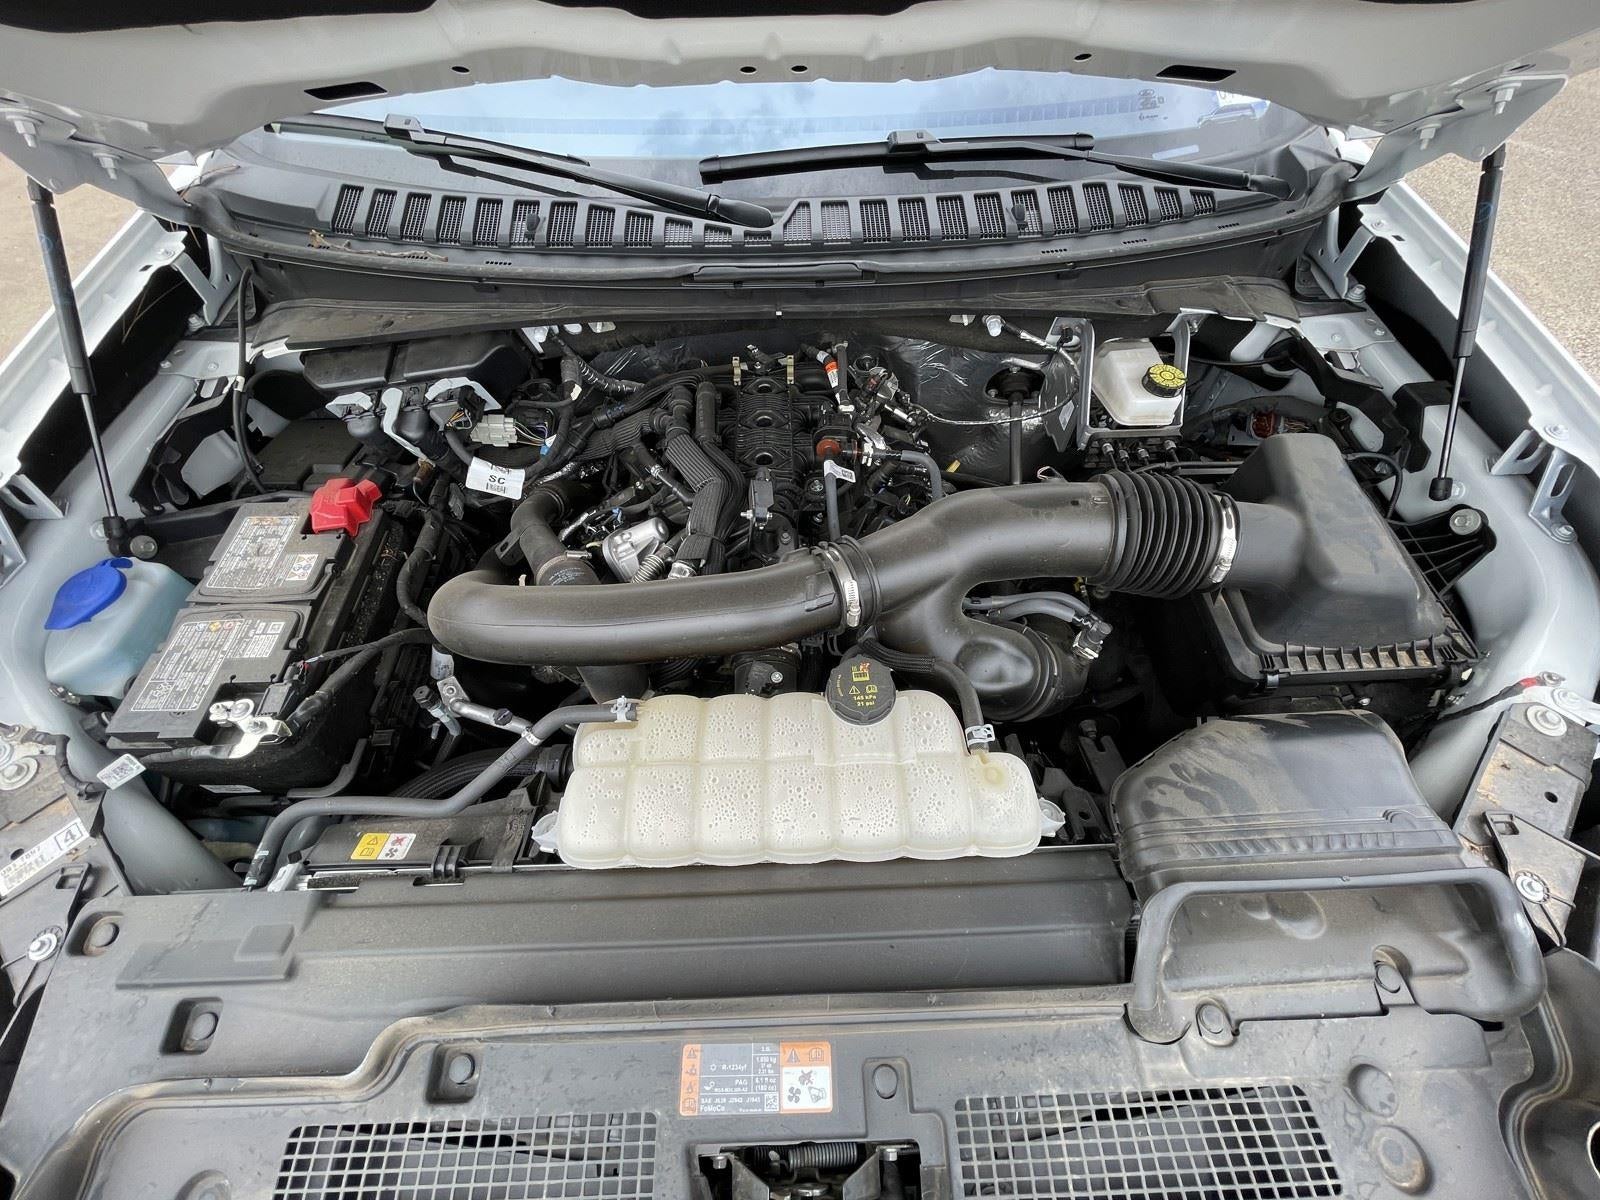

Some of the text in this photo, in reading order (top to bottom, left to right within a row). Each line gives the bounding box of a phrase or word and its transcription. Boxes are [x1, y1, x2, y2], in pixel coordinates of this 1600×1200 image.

[488, 474, 506, 485] SC
[64, 829, 77, 842] 4
[722, 1063, 747, 1072] R-1234yf
[700, 1104, 725, 1112] FoMoCo
